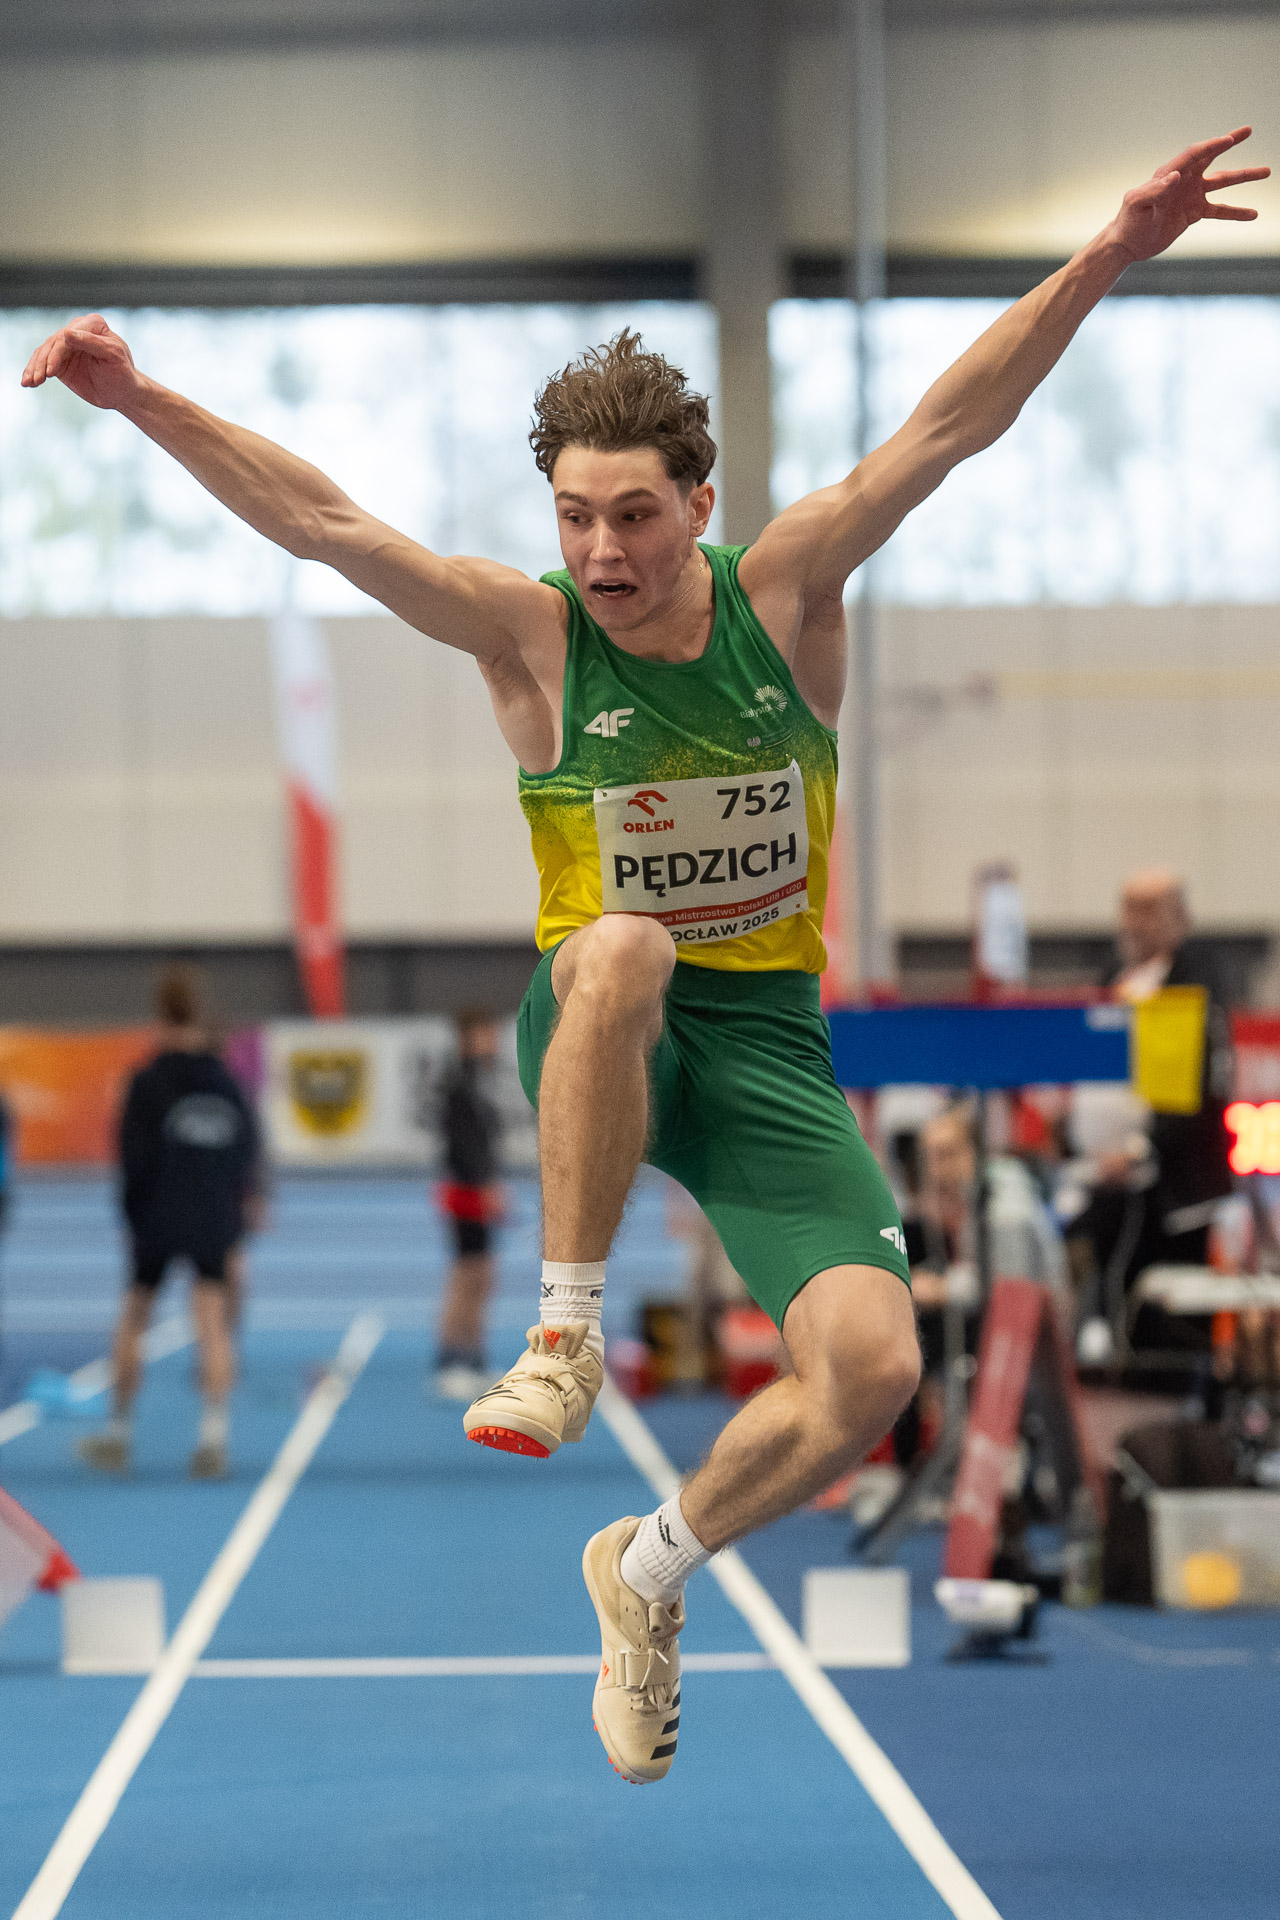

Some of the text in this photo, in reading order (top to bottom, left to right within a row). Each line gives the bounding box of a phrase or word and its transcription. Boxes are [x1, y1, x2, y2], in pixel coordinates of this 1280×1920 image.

[583, 708, 635, 738] 4F
[717, 780, 791, 819] 752
[623, 819, 675, 833] ORLEN
[614, 832, 797, 897] PĘDZICH
[675, 908, 736, 921] Mistrzostwa
[738, 898, 764, 912] Polski
[766, 892, 780, 903] U18
[786, 882, 802, 894] U20
[670, 906, 779, 941] OCŁAW 2025
